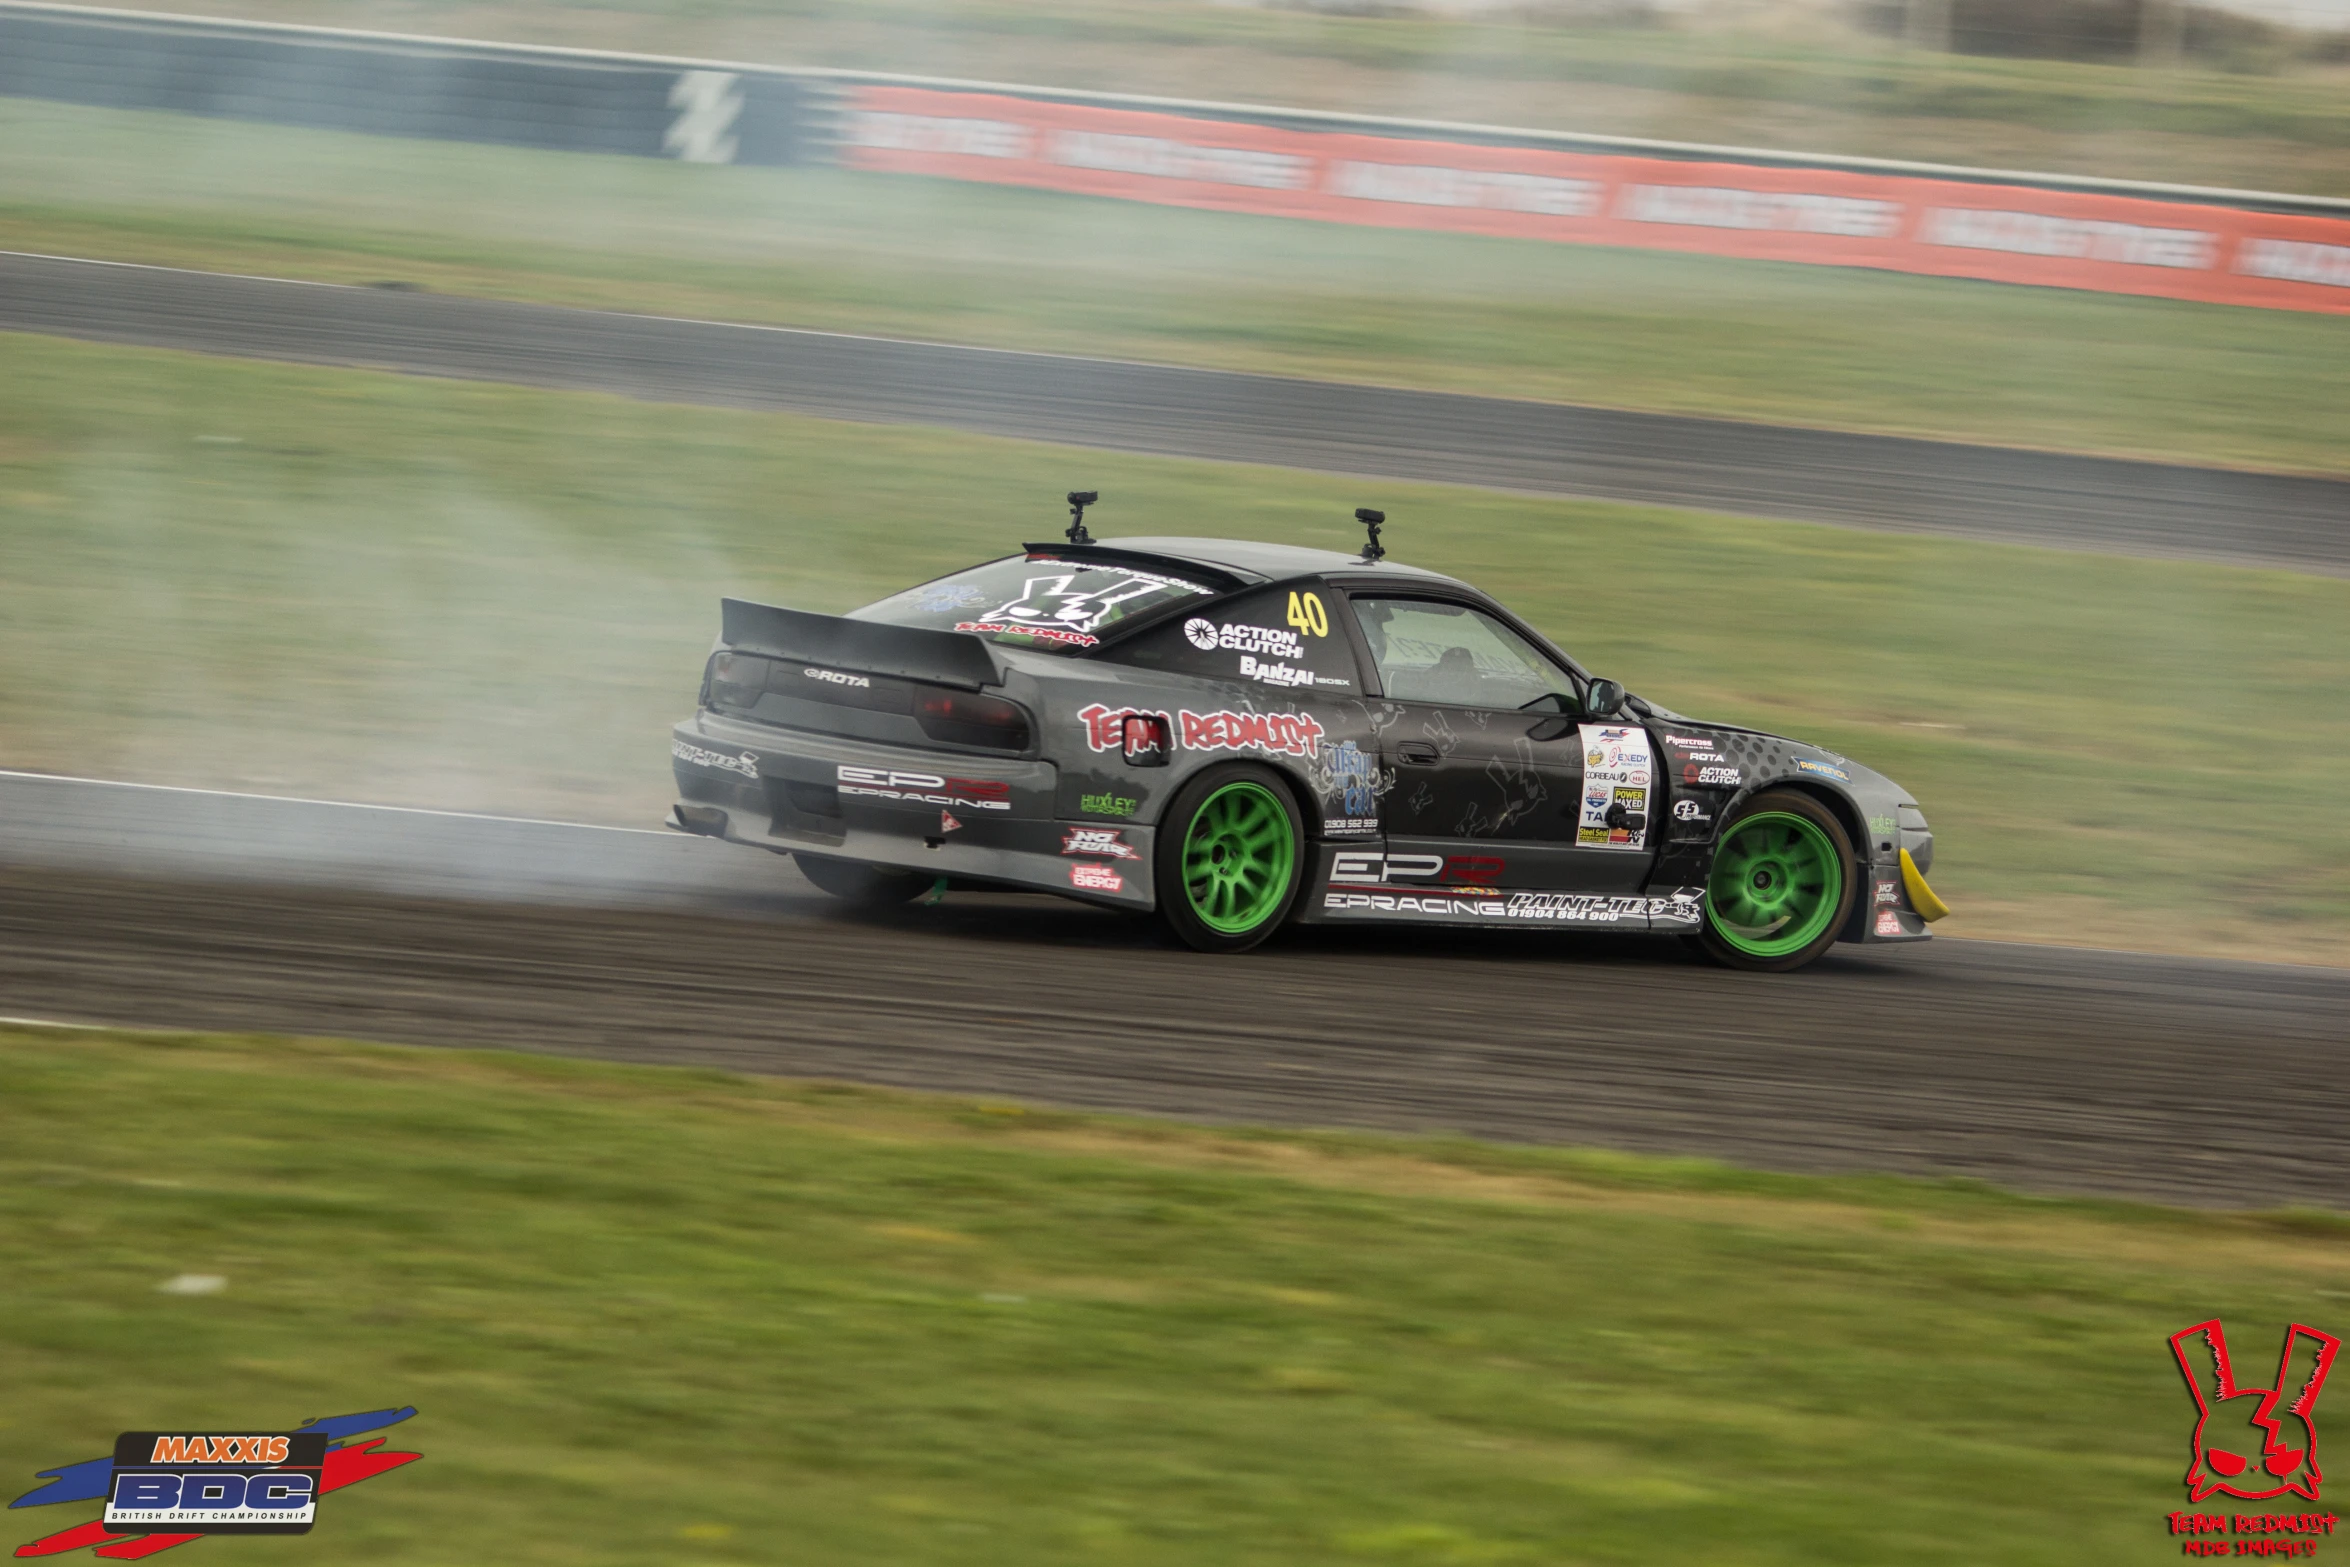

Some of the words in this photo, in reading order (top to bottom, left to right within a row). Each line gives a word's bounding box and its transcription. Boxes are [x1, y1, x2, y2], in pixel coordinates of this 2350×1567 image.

[1287, 591, 1328, 637] 40
[1219, 623, 1297, 645] ACTION
[1218, 635, 1301, 659] CLUTCH
[1240, 655, 1314, 687] BANZAI
[818, 670, 870, 688] ROTA
[1077, 703, 1176, 756] TEAM
[1665, 735, 1713, 747] Pipercross
[1617, 752, 1648, 763] EXEDY
[1690, 753, 1724, 762] ROTA
[1585, 771, 1619, 781] CORBEAU
[1699, 767, 1738, 777] ACTION
[1800, 760, 1850, 781] RAVENOL
[1698, 775, 1741, 785] CLUTCH
[837, 785, 1011, 810] EPRACING
[1615, 790, 1643, 800] POWER
[1074, 831, 1116, 843] NO
[1579, 827, 1595, 836] Steel
[1595, 828, 1609, 837] Seal
[1324, 893, 1506, 916] EPRACING
[1507, 893, 1668, 915] PAINT-TEC
[1508, 908, 1554, 918] 01904
[1557, 910, 1586, 920] 864
[1589, 911, 1620, 921] 900
